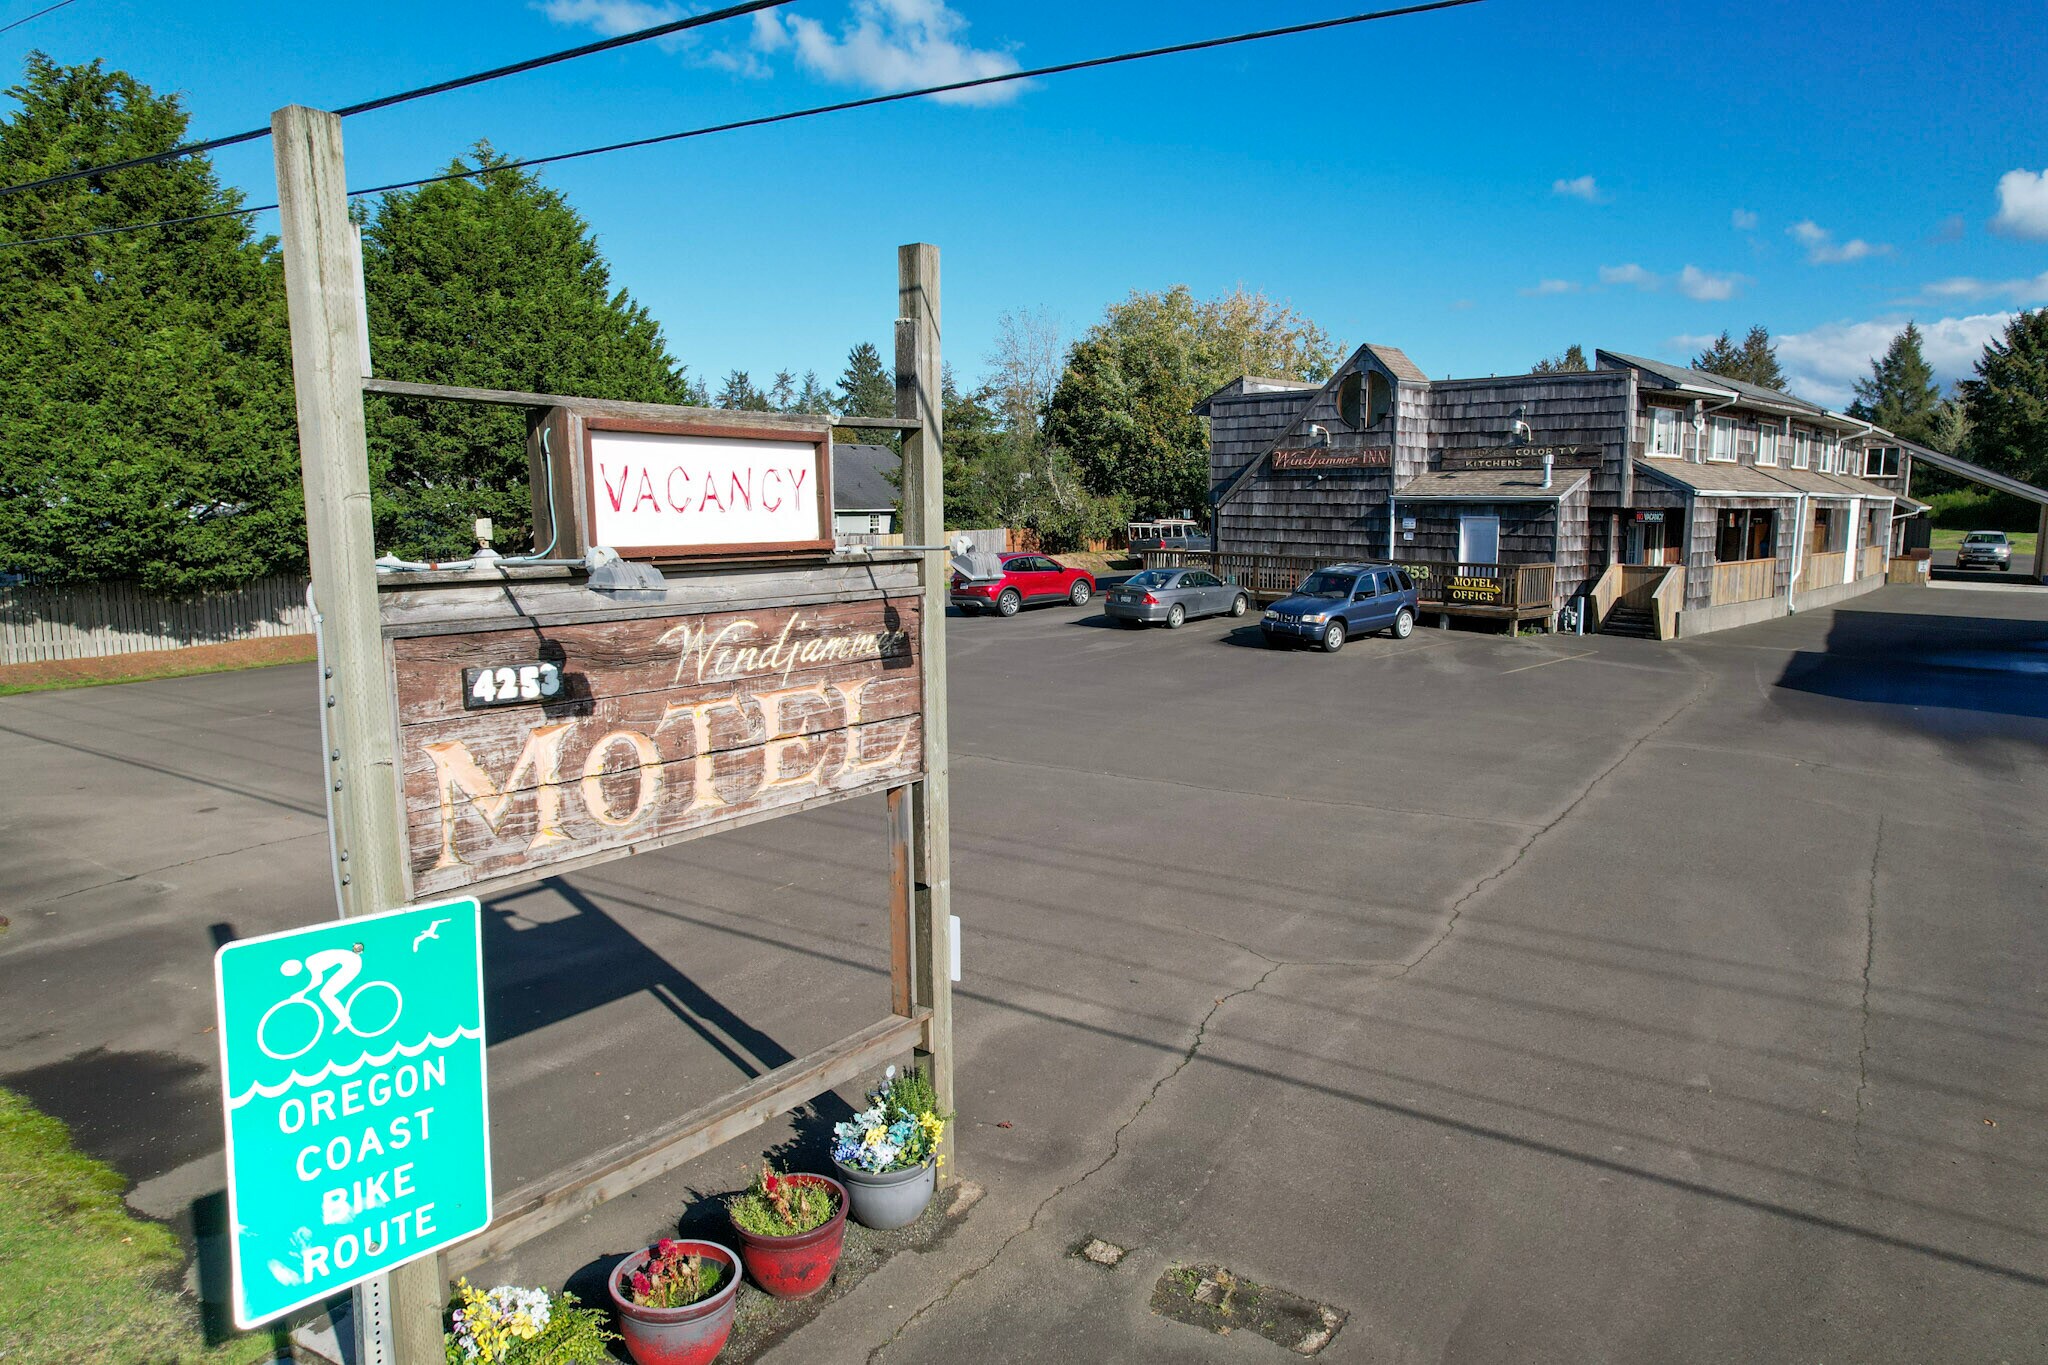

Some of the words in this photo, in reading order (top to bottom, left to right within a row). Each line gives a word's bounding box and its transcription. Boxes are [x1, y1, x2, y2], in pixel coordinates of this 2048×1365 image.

[1273, 449, 1359, 468] Windjammer
[1362, 450, 1387, 464] INN
[1465, 459, 1522, 467] KITCHENS
[1515, 447, 1553, 456] COLOR
[1559, 446, 1578, 455] TV
[600, 463, 806, 513] VACANCY
[1644, 513, 1665, 521] VACANCY
[1401, 565, 1429, 580] 253
[1454, 577, 1495, 589] MOTEL
[1452, 590, 1495, 601] OFFICE
[657, 612, 904, 687] Windjammer
[472, 662, 562, 702] 4253
[420, 677, 920, 870] MOTEL
[278, 1055, 447, 1134] OREGON
[295, 1107, 436, 1182] COAST
[323, 1162, 416, 1226] BIKE
[303, 1202, 437, 1284] ROUTE
